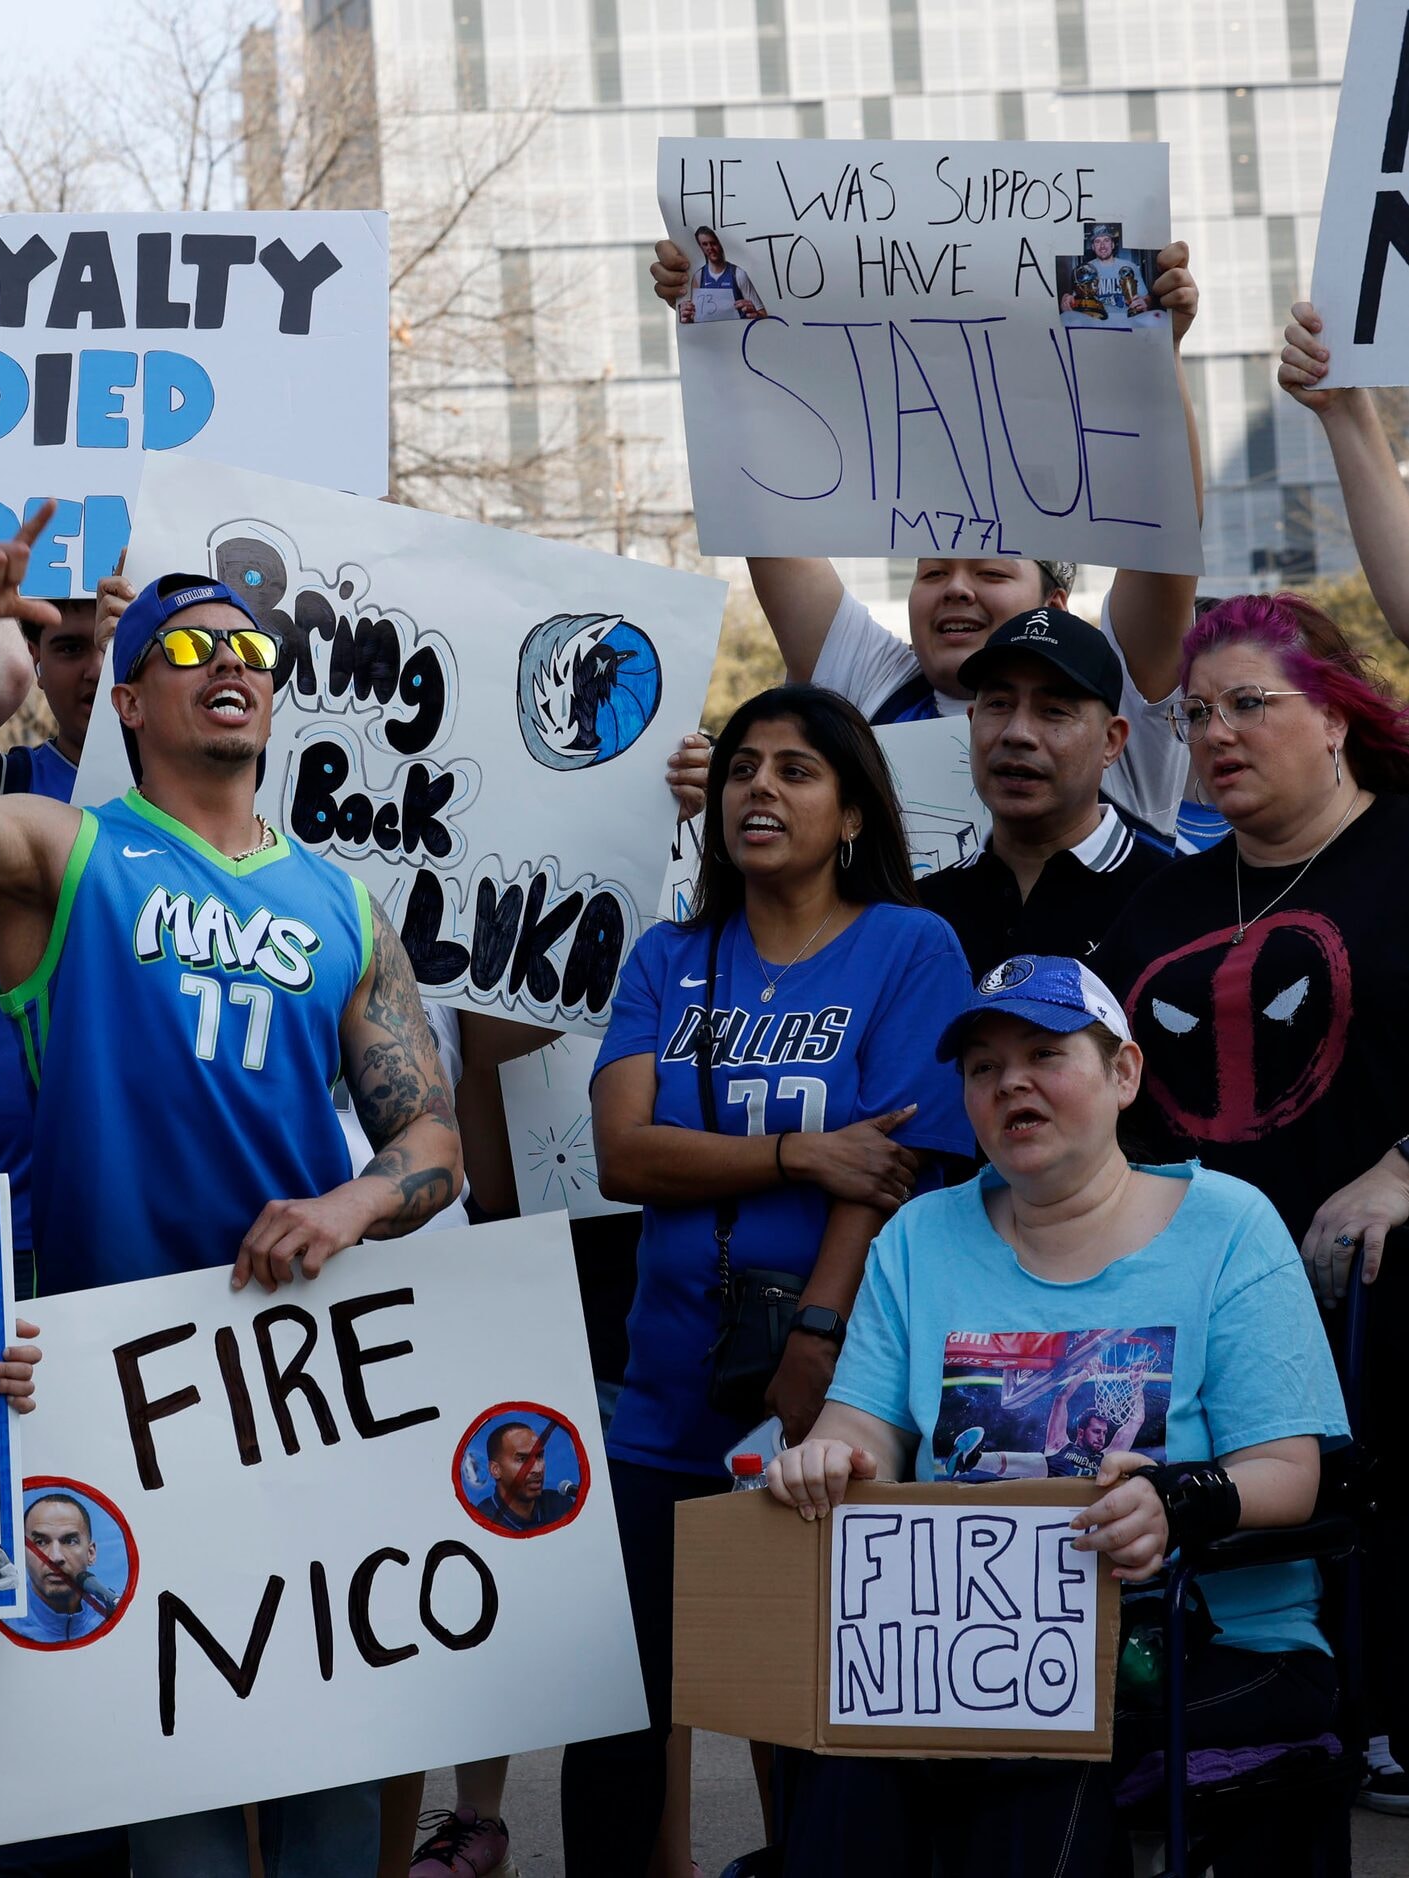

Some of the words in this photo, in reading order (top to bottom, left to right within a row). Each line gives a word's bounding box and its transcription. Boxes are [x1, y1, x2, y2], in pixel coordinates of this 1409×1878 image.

[679, 157, 748, 230] HE
[776, 161, 895, 223] WAS
[928, 156, 1097, 225] SUPPOSE
[746, 233, 825, 299] TO
[859, 234, 974, 297] HAVE
[1015, 236, 1055, 298] A
[741, 316, 1161, 528] STATUE
[174, 586, 215, 606] DALLAS
[135, 886, 321, 992] MAVS
[399, 871, 625, 1014] LUKA
[179, 973, 274, 1071] 77
[660, 1004, 852, 1068] DALLAS
[113, 1287, 440, 1491] FIRE
[841, 1514, 1089, 1623] FIRE
[158, 1539, 499, 1736] NICO
[837, 1621, 1078, 1717] NICO
